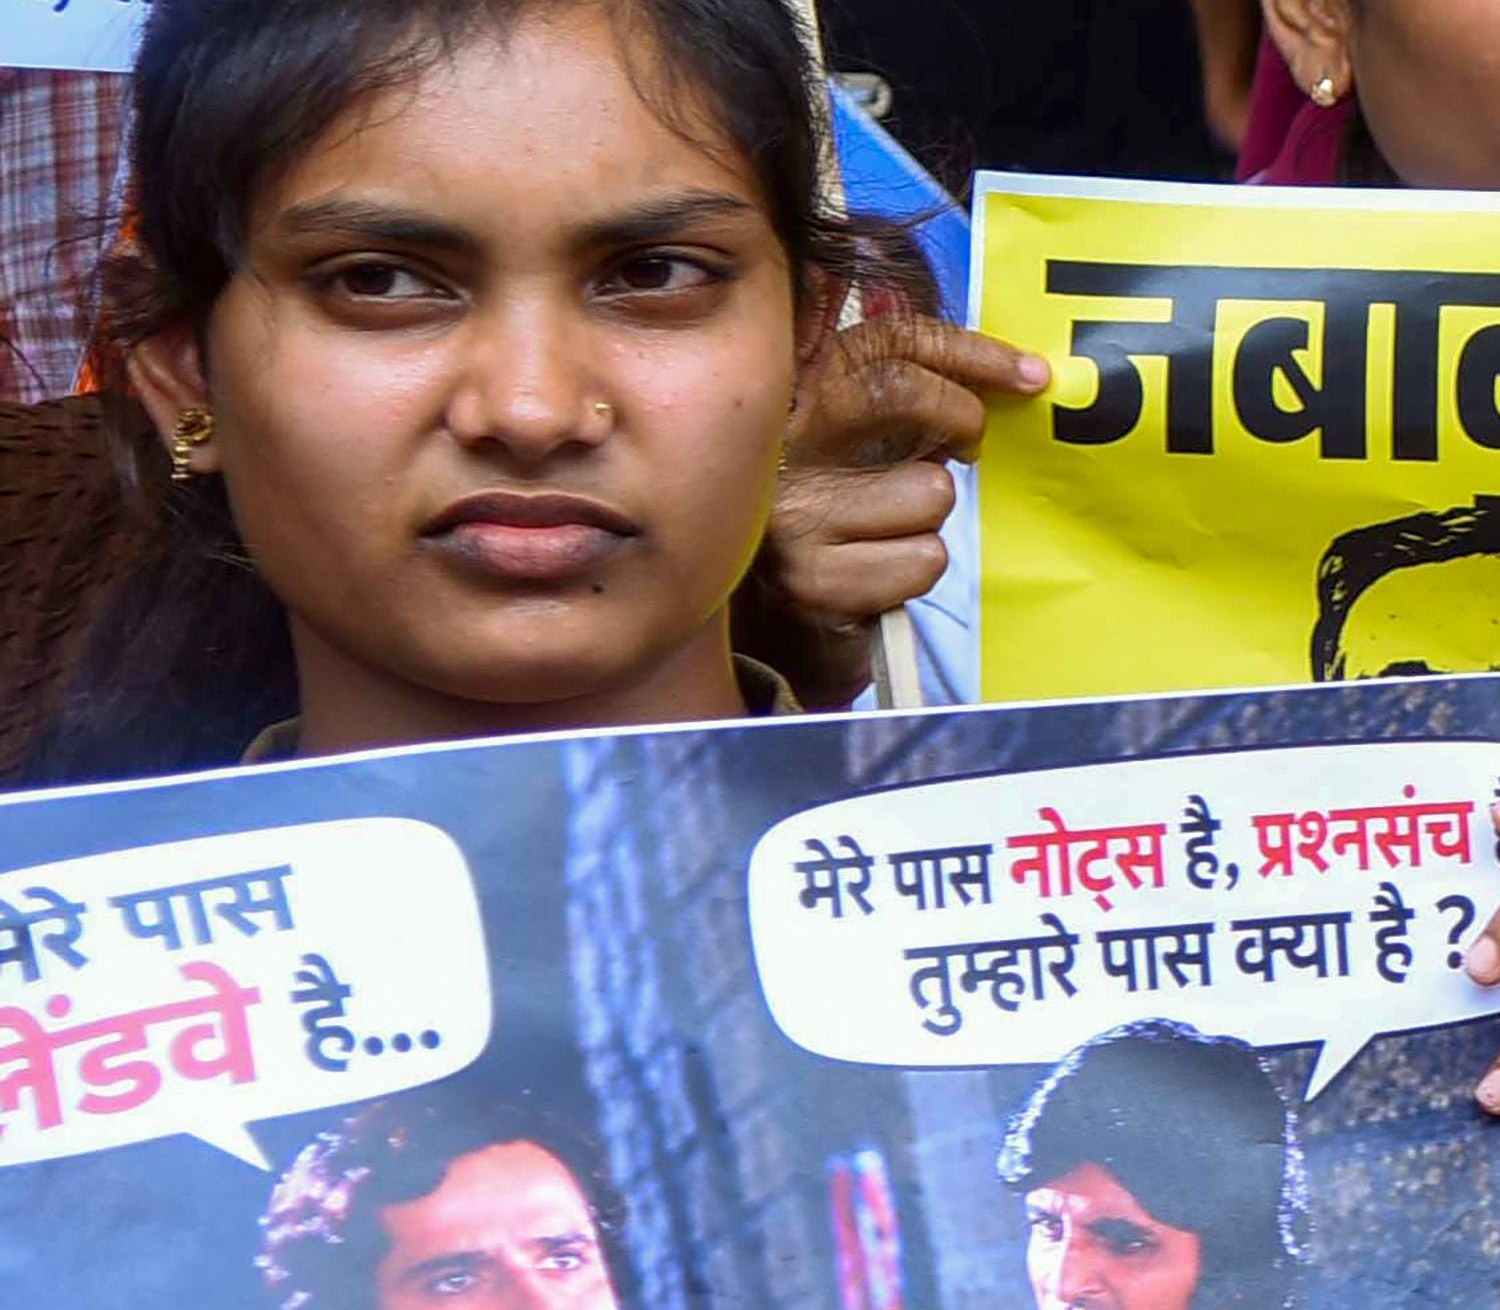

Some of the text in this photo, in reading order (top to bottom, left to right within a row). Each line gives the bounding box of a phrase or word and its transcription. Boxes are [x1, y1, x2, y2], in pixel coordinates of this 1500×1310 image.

[107, 864, 295, 952] पास
[793, 835, 876, 918] मेरे
[889, 845, 993, 910] पास
[1006, 806, 1167, 910] नोट्स
[1184, 796, 1240, 892] है,
[1252, 784, 1474, 876] प्रश्नसंच
[904, 914, 1078, 1036] तुम्हारे
[1096, 924, 1212, 994] पास
[1230, 912, 1352, 984] क्या
[1366, 883, 1416, 984] है
